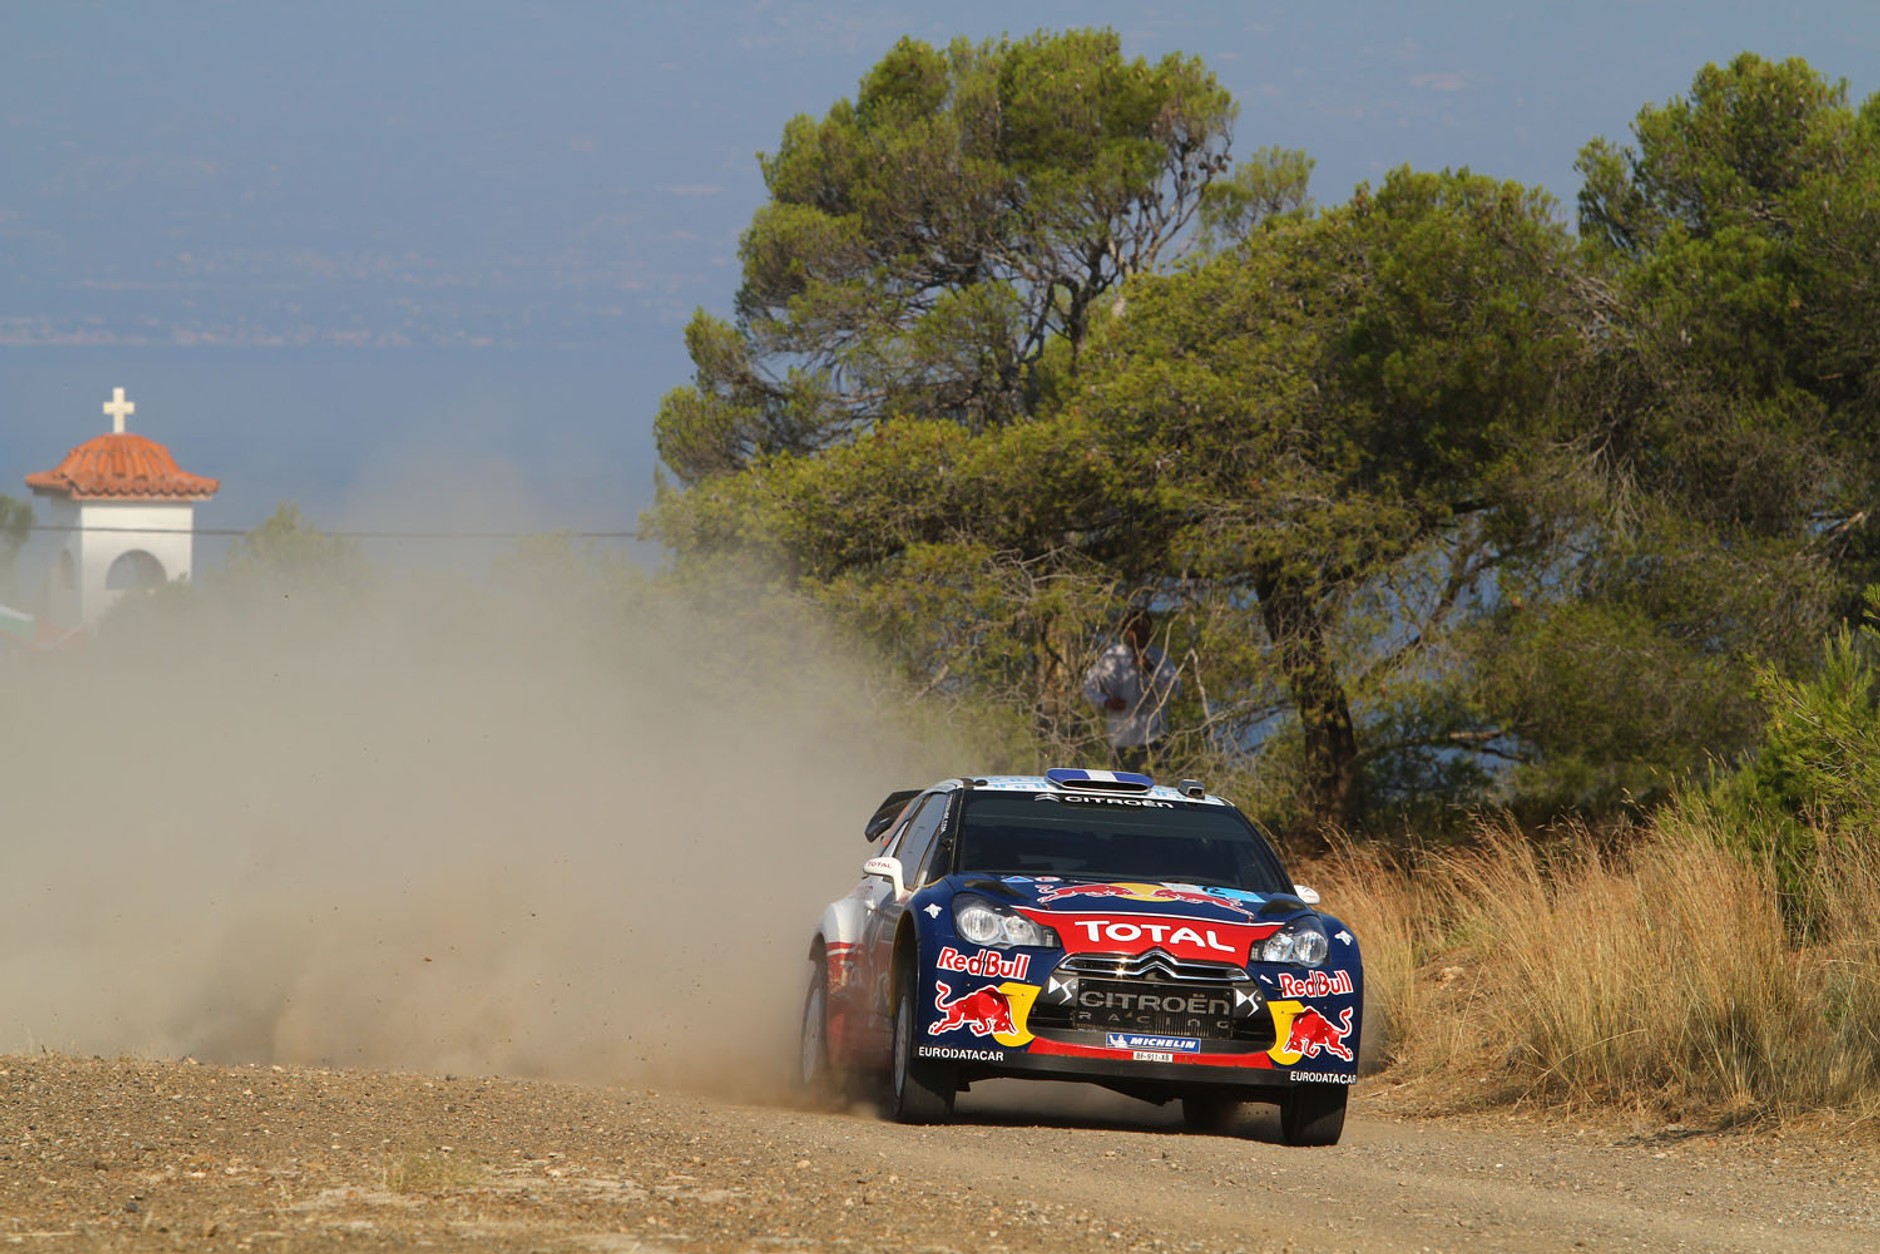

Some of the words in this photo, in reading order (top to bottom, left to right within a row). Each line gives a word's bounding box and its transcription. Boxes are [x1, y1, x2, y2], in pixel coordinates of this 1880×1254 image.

[867, 861, 892, 869] TOTAL
[1074, 920, 1236, 952] TOTAL
[937, 946, 986, 976] Red
[983, 951, 1031, 980] Bull
[1278, 969, 1317, 998] Red
[1315, 970, 1354, 997] Bull
[1130, 1037, 1196, 1049] MICHELIN
[918, 1046, 1004, 1061] EURODATACAR
[1289, 1071, 1357, 1084] EURODATACAR
